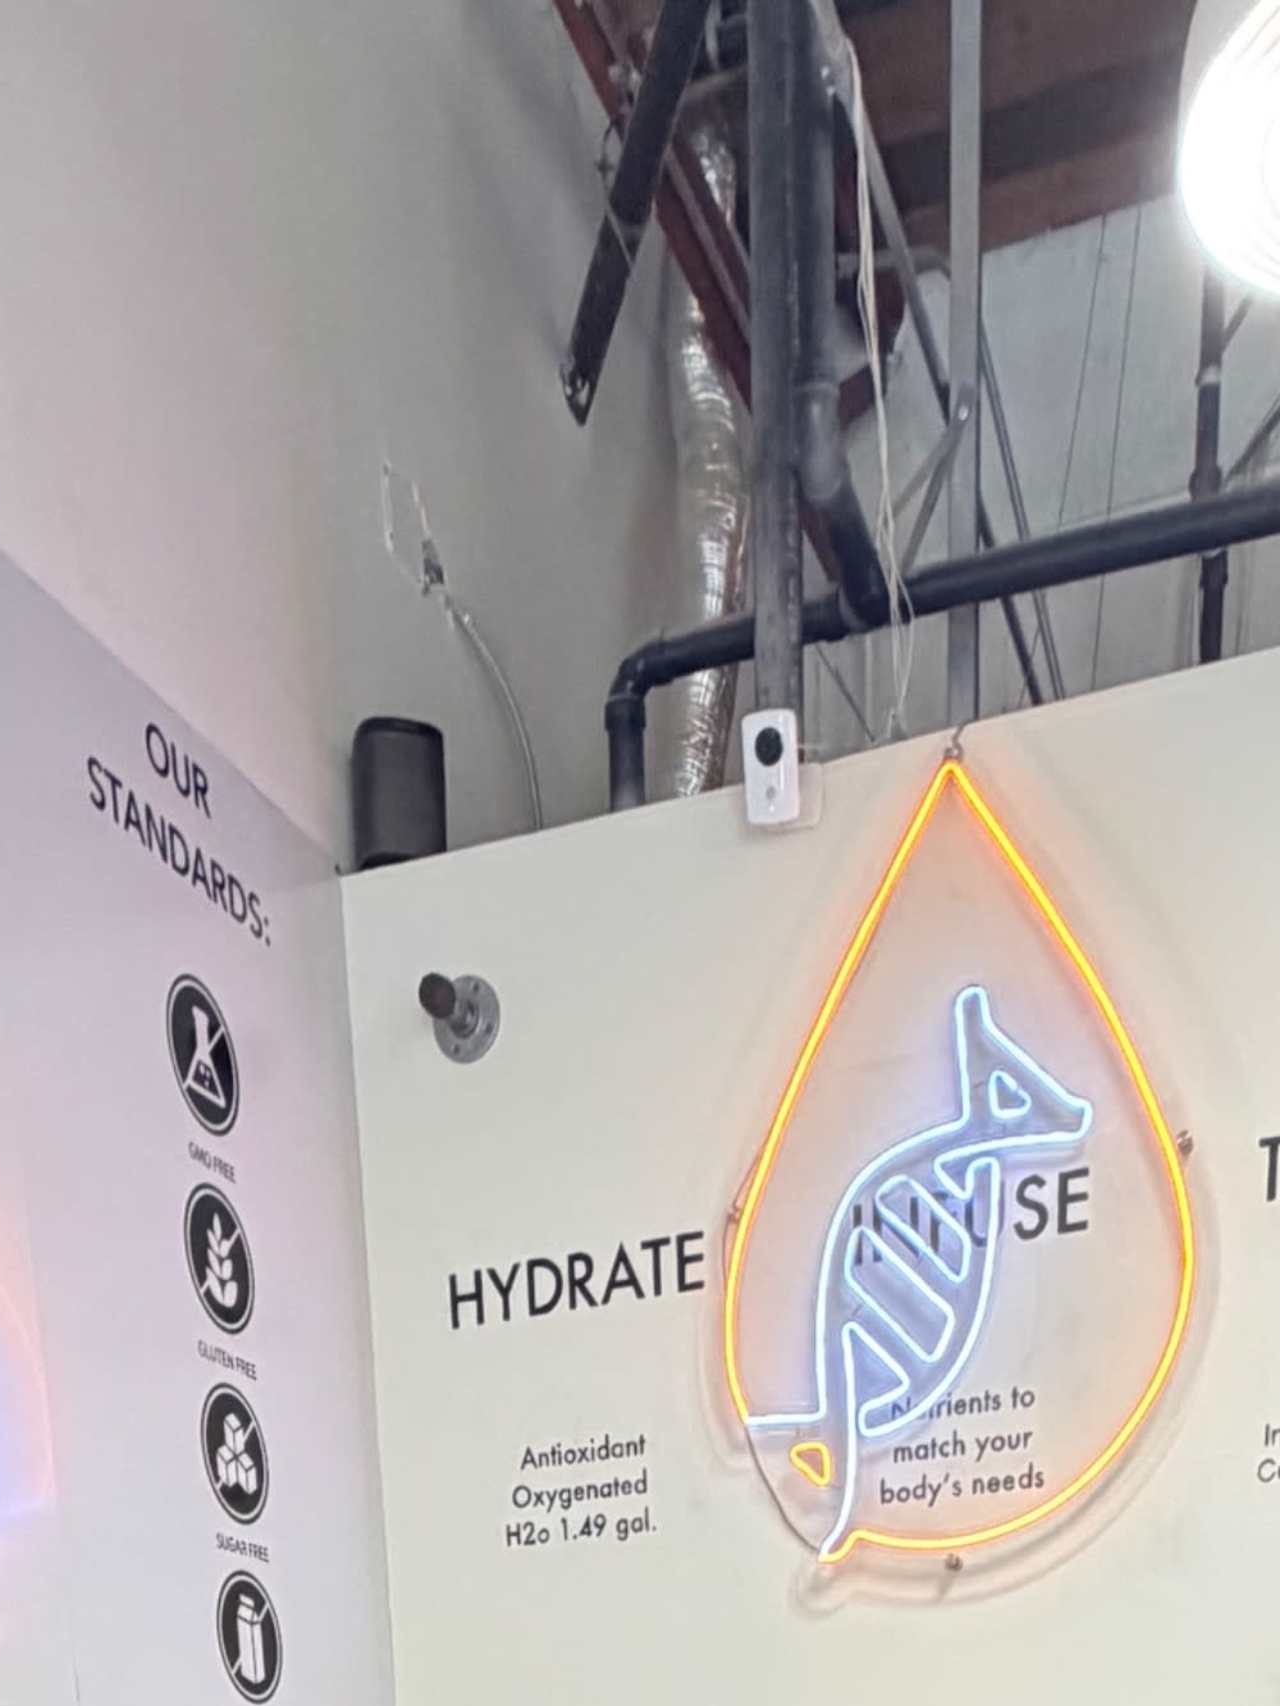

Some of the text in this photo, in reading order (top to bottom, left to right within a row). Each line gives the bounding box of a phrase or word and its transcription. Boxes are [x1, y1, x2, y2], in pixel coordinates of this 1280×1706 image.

[145, 722, 212, 818] OUR
[87, 757, 272, 947] STANDARDS:
[188, 1141, 236, 1184] GMO FREE
[853, 1167, 1089, 1266] INFUSE
[448, 1230, 706, 1330] HYDRATE
[198, 1340, 257, 1381] GLUTEN FREE
[891, 1386, 1036, 1420] Nrients to
[520, 1434, 646, 1472] Antioxidant
[893, 1426, 1034, 1464] match your
[512, 1472, 648, 1516] Oxygenated
[880, 1466, 1045, 1507] body's needs
[216, 1532, 270, 1564] SUGAR FREE
[505, 1506, 658, 1549] H2o 1.49 gal.
